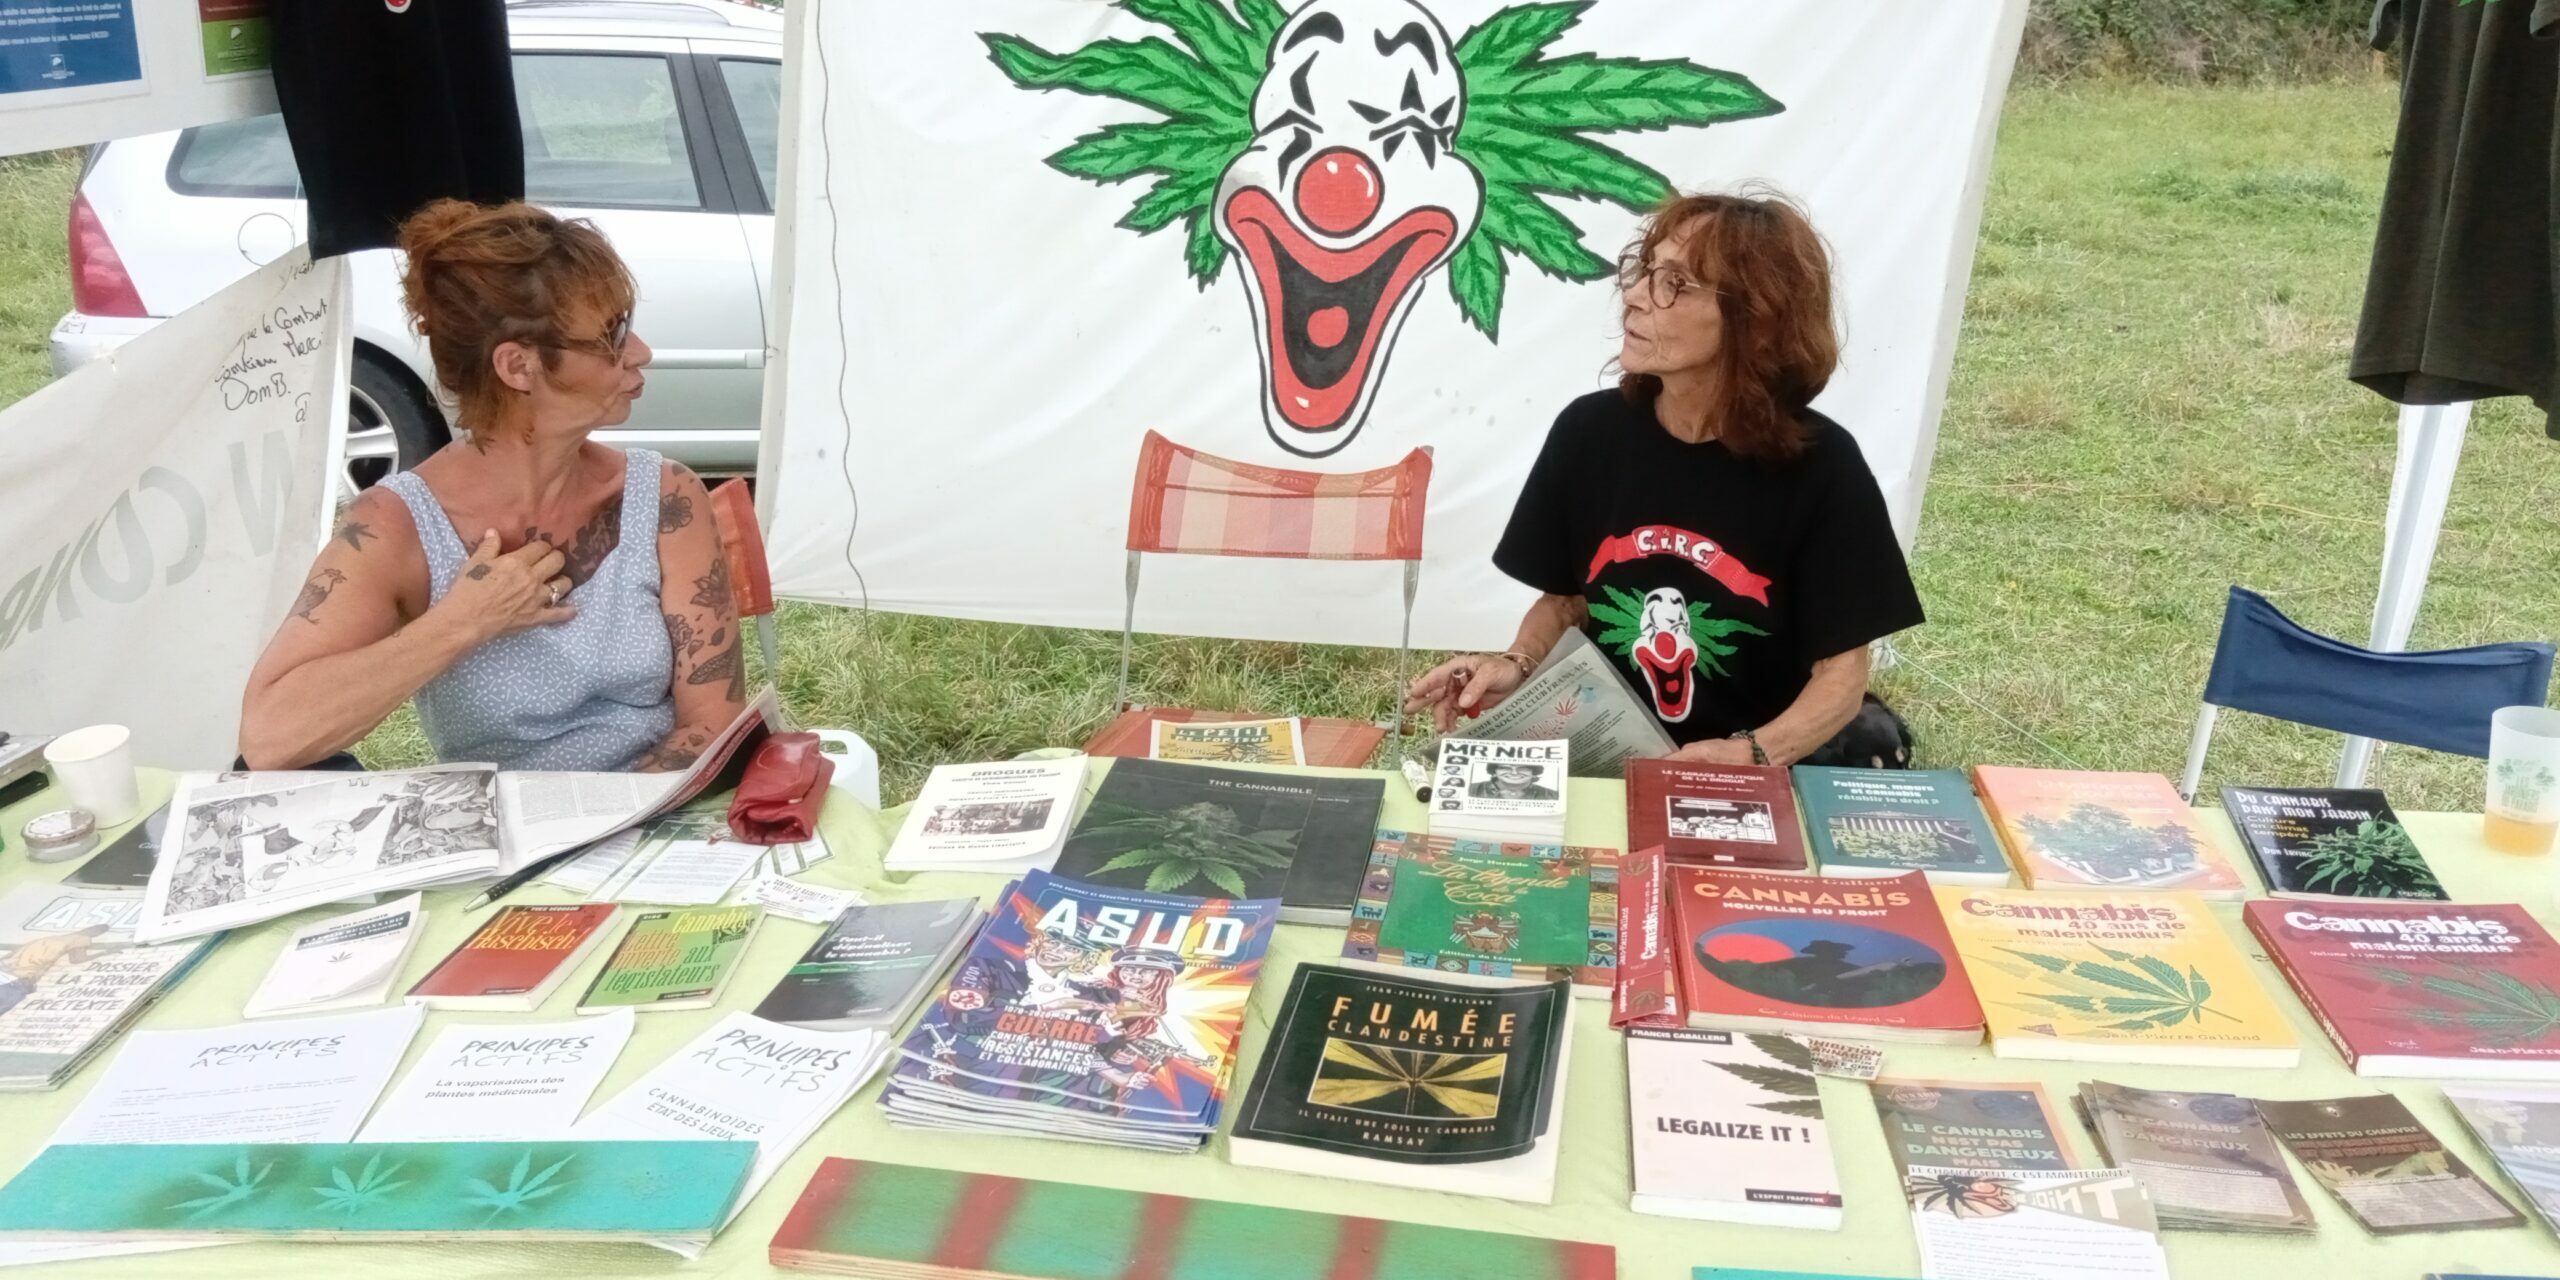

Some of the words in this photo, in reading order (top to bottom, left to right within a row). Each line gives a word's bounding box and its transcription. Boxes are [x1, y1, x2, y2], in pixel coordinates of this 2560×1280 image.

[274, 299, 328, 331] Combat
[1504, 676, 1550, 715] CONDUITE
[1494, 704, 1530, 730] SOCIAL
[1178, 729, 1201, 737] LE
[1202, 726, 1263, 737] PETIT
[1444, 743, 1488, 757] MR
[971, 768, 1046, 777] DROGUES
[1718, 773, 1765, 781] POLITIQUE
[1208, 778, 1232, 788] THE
[1235, 782, 1313, 795] CANNABIBLE
[1832, 780, 1891, 791] Politique,
[1865, 789, 1922, 798] cannabis
[2263, 795, 2333, 809] CANNABIS
[2242, 804, 2278, 816] DANS
[2282, 806, 2317, 818] MON
[2320, 809, 2372, 820] JARDIN
[2247, 815, 2296, 826] Culture
[2268, 824, 2310, 833] climat
[2254, 831, 2310, 840] tempéré
[1418, 861, 1468, 881] La
[1442, 880, 1518, 906] Coca
[1722, 902, 1807, 914] NOUVELLES
[1961, 898, 2177, 921] Cannabis
[499, 906, 554, 935] Vive
[671, 906, 753, 934] Cannabis
[1035, 898, 1245, 957] ASUD
[2068, 920, 2097, 930] 40
[2107, 921, 2148, 931] ans
[2155, 921, 2186, 931] de
[2284, 911, 2509, 936] Cannabis
[620, 928, 682, 951] Lettre
[838, 934, 885, 943] Faut-il
[1640, 912, 1658, 960] Cannabis
[2017, 928, 2176, 940] malentendus
[2400, 934, 2431, 944] 40
[2438, 935, 2482, 945] ans
[2488, 934, 2521, 945] de
[825, 951, 836, 959] le
[839, 949, 901, 959] cannabis
[832, 941, 912, 951] dépénaliser
[2350, 941, 2514, 954] malentendus
[609, 948, 683, 970] ouverte
[682, 944, 719, 965] aux
[55, 974, 82, 985] LA
[87, 973, 157, 986] DROGUE
[603, 963, 721, 995] législateurs
[56, 987, 122, 999] COMME
[1331, 996, 1517, 1035] FUMÉE
[995, 1013, 1100, 1044] GUERRE
[1327, 1018, 1513, 1049] CLANDESTINE
[1631, 1029, 1672, 1039] FRANCIS
[1672, 1031, 1727, 1043] CABALLERO
[460, 1035, 596, 1054] PRINCIPES
[990, 1030, 1032, 1044] CONTRE
[1034, 1037, 1047, 1046] LA
[196, 1034, 347, 1059] PRINCIPES
[715, 1028, 851, 1072] PRINCIPES
[1811, 1044, 1874, 1061] ANNABIS
[978, 1051, 994, 1062] ET
[996, 1054, 1090, 1076] COLLABORATIONS
[435, 1078, 453, 1088] La
[456, 1077, 539, 1089] vaporisation
[541, 1076, 566, 1085] des
[424, 1089, 476, 1099] plantes
[478, 1086, 560, 1097] médicinales
[648, 1087, 766, 1136] CANNABINOÏDES
[647, 1101, 676, 1120] ETAT
[672, 1111, 701, 1129] DES
[699, 1121, 739, 1142] LIEUX
[1355, 1118, 1377, 1129] UNE
[1383, 1122, 1411, 1133] FOIS
[1417, 1125, 1430, 1134] LE
[1436, 1124, 1496, 1135] CANNABIS
[2145, 1118, 2242, 1134] CANNABIS
[1657, 1116, 1765, 1141] LEGALIZE
[1770, 1125, 1792, 1143] IT
[1801, 1127, 1811, 1144] !
[1902, 1121, 1927, 1134] LE
[1932, 1124, 2046, 1140] CANNABIS
[2286, 1131, 2305, 1140] LES
[2307, 1131, 2346, 1140] EFFETS
[2348, 1130, 2363, 1138] DU
[2365, 1126, 2419, 1137] CHANVRE
[1362, 1131, 1425, 1147] RAMSAY
[1990, 1137, 2024, 1149] PAS
[2122, 1131, 2251, 1152] DANGEREUX
[1906, 1142, 2060, 1162] DANGEREUX
[1952, 1157, 2002, 1169] MAIS
